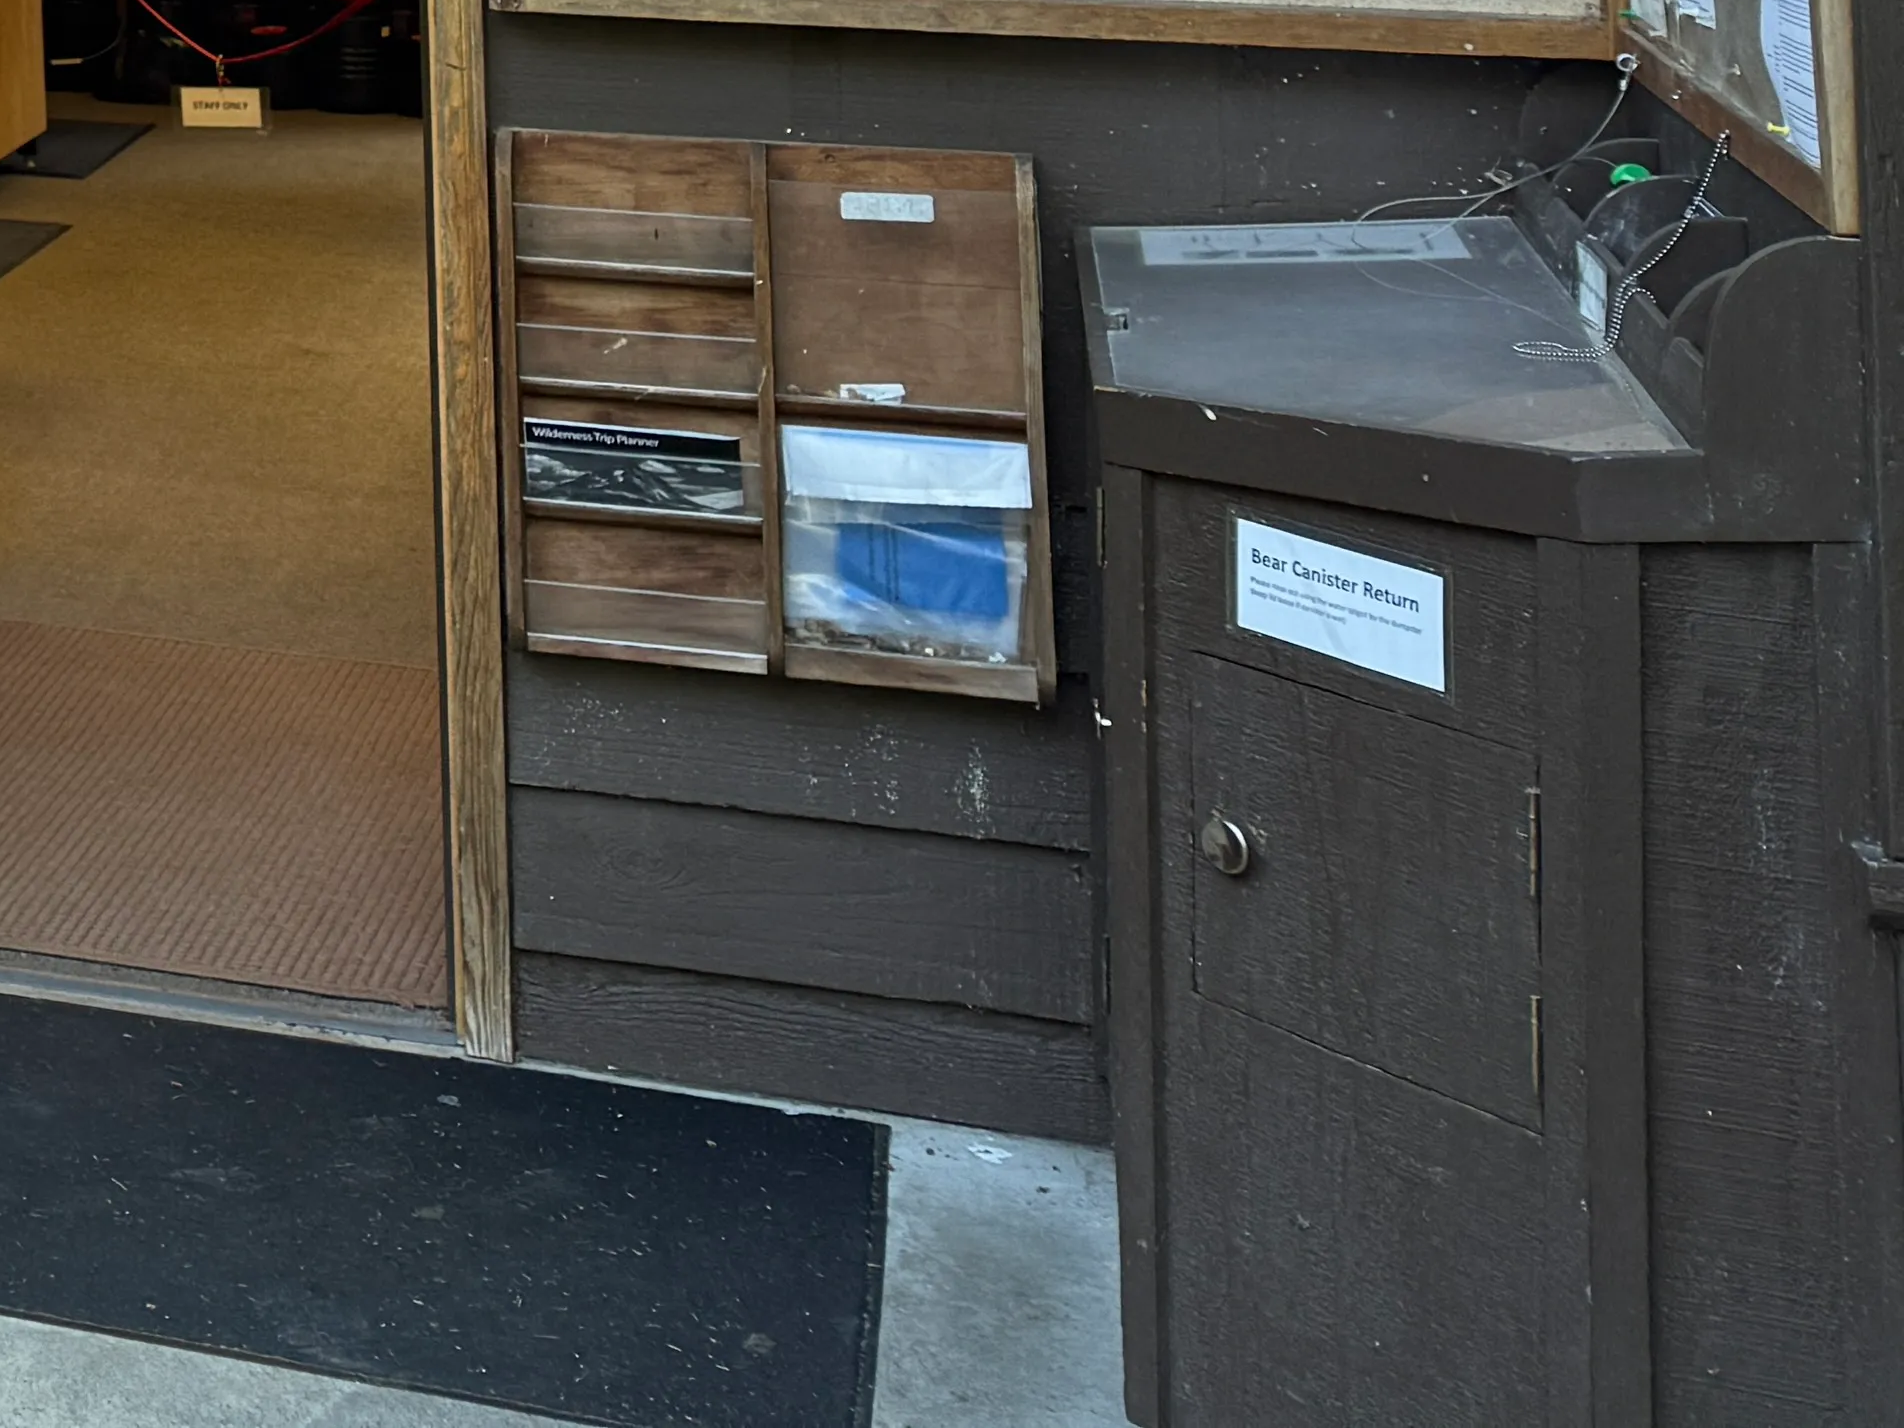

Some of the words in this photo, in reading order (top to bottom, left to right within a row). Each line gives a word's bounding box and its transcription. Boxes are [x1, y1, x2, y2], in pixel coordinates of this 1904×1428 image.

[192, 100, 221, 111] STAFF
[222, 101, 249, 111] ONLY
[532, 426, 593, 442] Wilderness
[593, 431, 615, 445] Trip
[616, 433, 660, 448] Planner
[1250, 547, 1288, 574] Bear
[1291, 560, 1359, 595] Canister
[1362, 581, 1420, 614] Return
